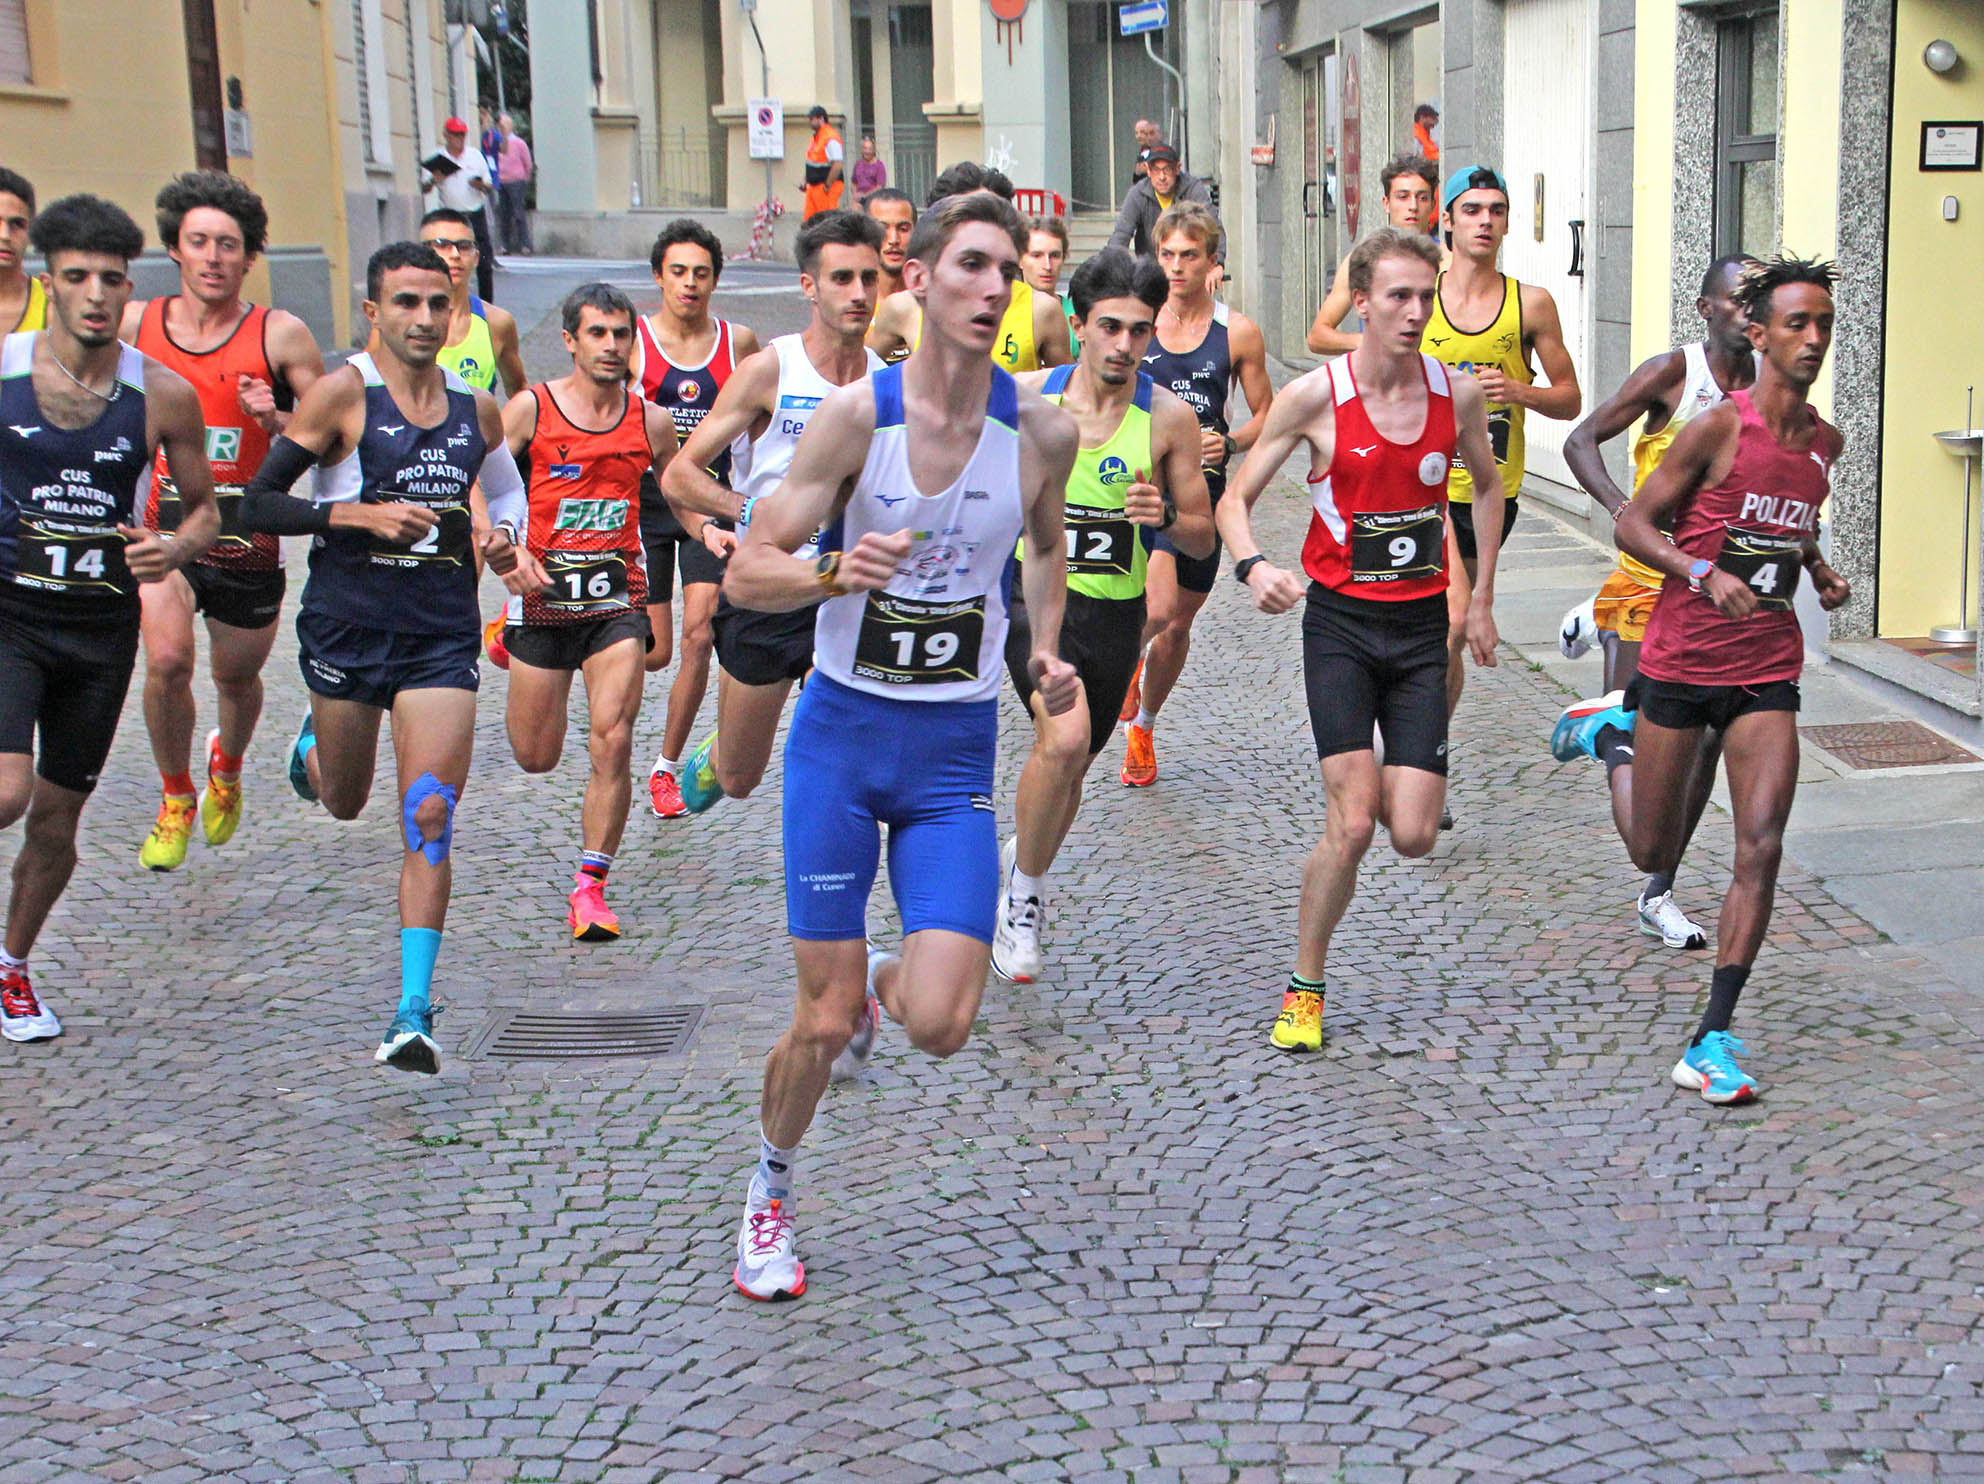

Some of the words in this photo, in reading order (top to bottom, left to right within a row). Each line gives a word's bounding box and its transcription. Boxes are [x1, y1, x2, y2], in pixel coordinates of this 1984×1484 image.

[1192, 371, 1210, 379] pwc
[1171, 380, 1191, 390] CUS
[1177, 392, 1211, 407] PATRIA
[664, 406, 712, 418] TLETIC
[447, 437, 469, 448] pwc
[94, 451, 124, 462] pwc
[420, 448, 447, 462] CUS
[60, 469, 92, 484] CUS
[396, 465, 424, 484] PRO
[427, 464, 469, 485] PATRIA
[407, 481, 461, 494] MILANO
[31, 483, 64, 501] PRO
[67, 484, 117, 508] PATRIA
[44, 499, 107, 518] MILANO
[554, 498, 630, 531] FAR
[1739, 492, 1818, 532] POLIZIA
[410, 523, 440, 554] 2
[1064, 529, 1113, 560] 12
[1388, 536, 1417, 567] 9
[44, 545, 105, 579] 14
[370, 556, 395, 566] 3000
[398, 559, 420, 568] TOP
[1066, 565, 1078, 573] OP
[15, 576, 41, 588] 3000
[44, 582, 67, 591] TOP
[564, 571, 611, 600] 16
[1353, 574, 1377, 582] 3000
[1379, 574, 1399, 582] TOP
[1750, 563, 1779, 594] 4
[567, 604, 585, 613] TOP
[890, 631, 960, 667] 19
[855, 665, 884, 680] 3000
[887, 674, 913, 684] TOP
